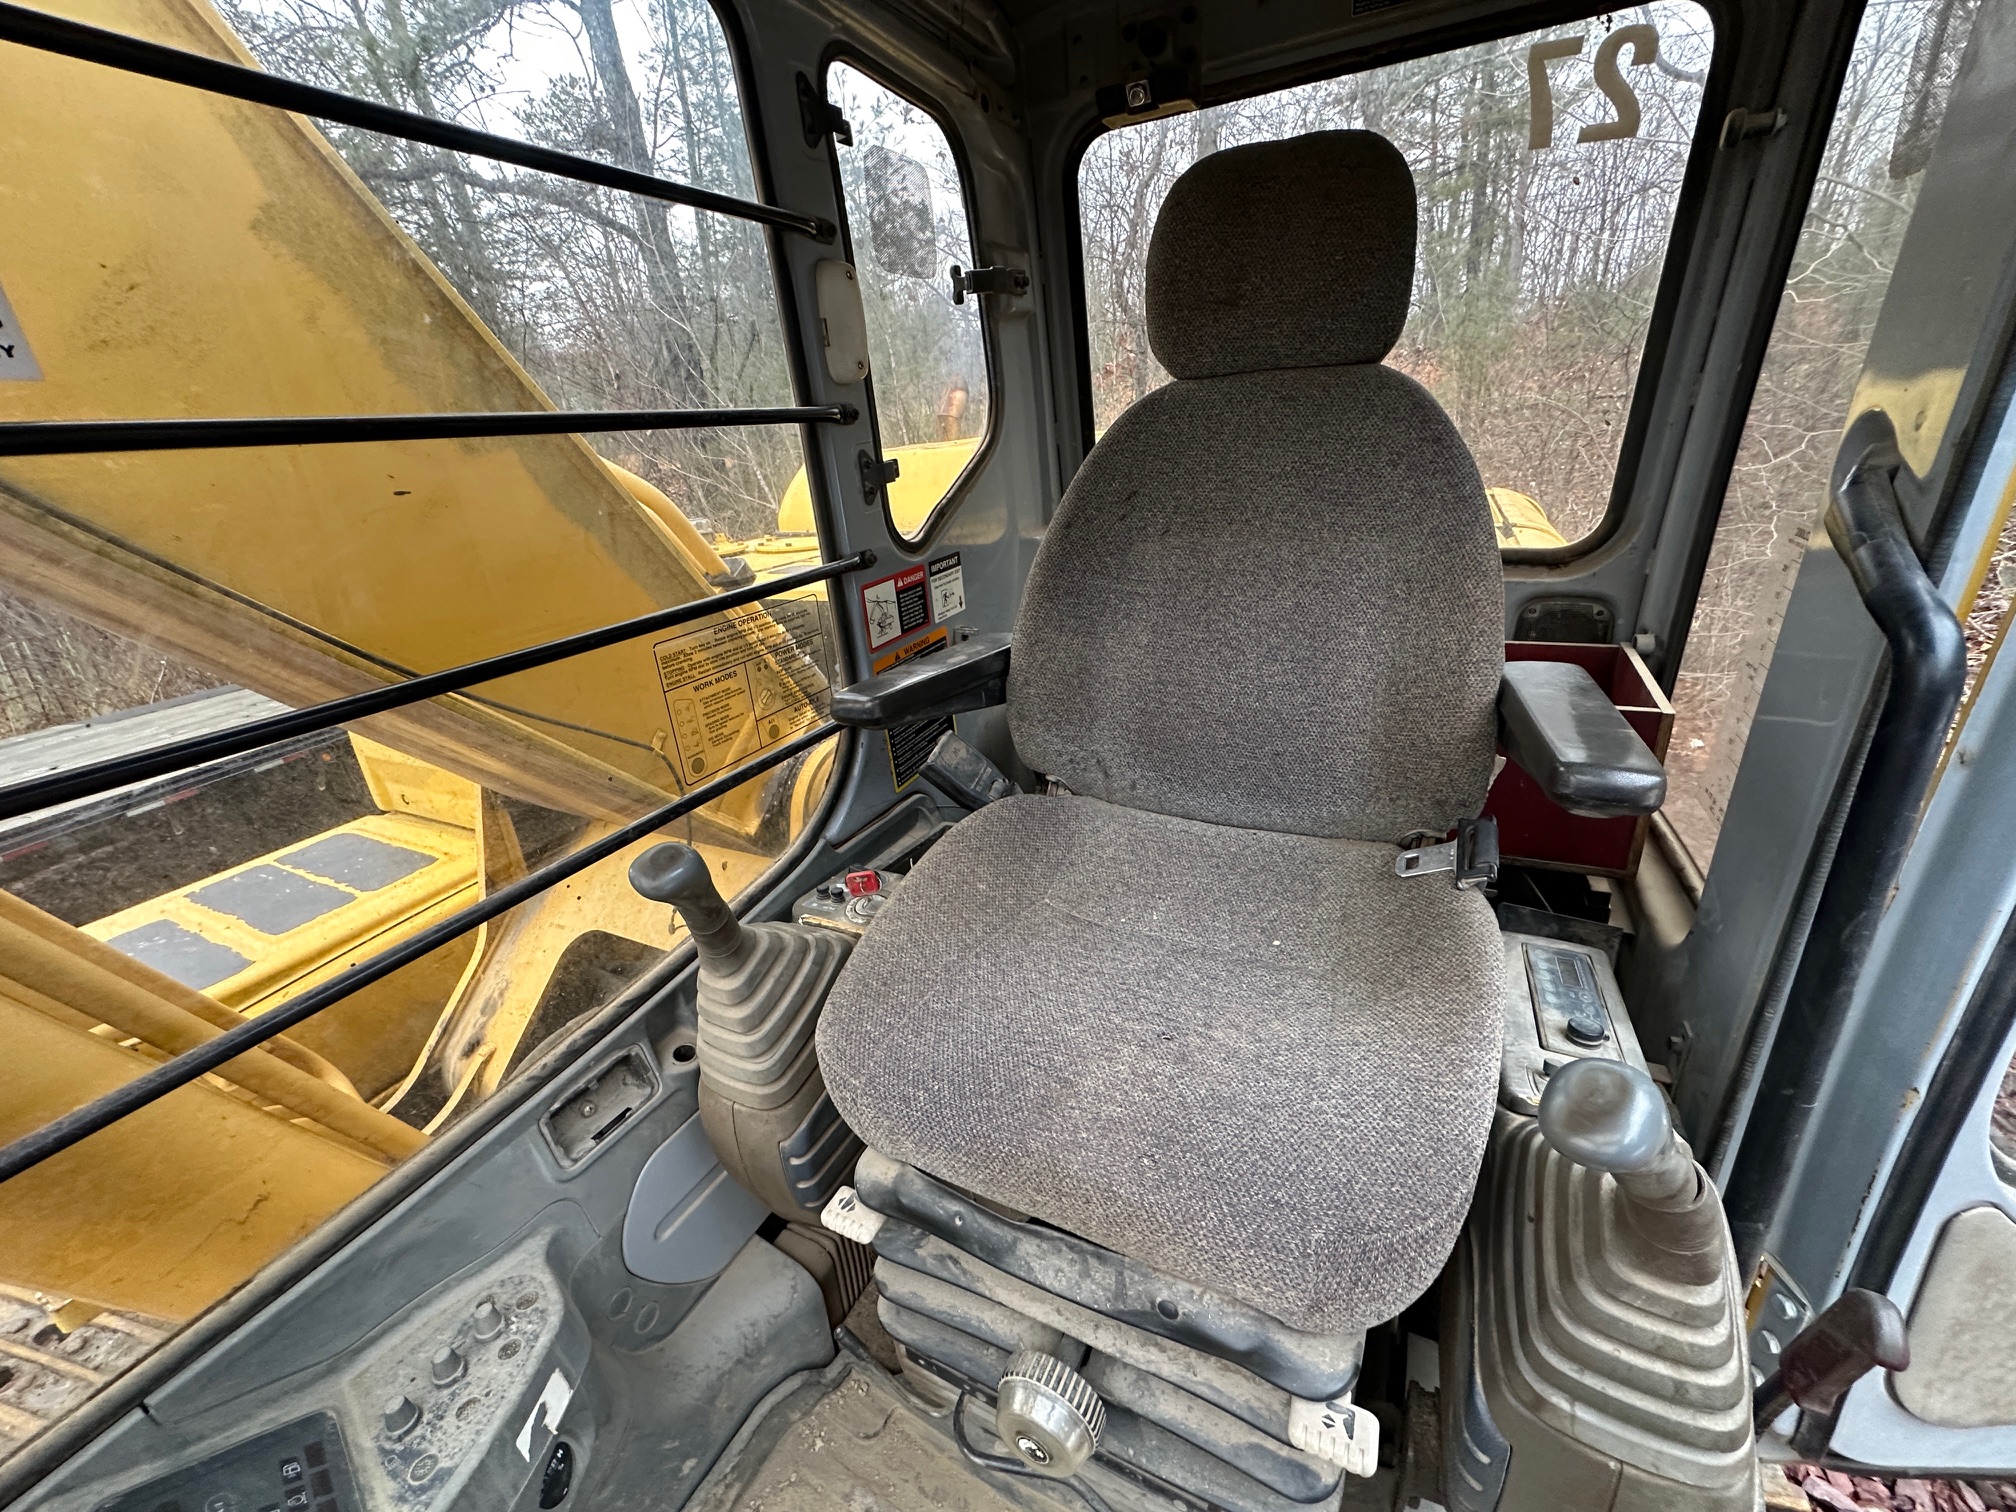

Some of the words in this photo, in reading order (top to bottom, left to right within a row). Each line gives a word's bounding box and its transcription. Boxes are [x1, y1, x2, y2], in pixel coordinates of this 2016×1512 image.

[930, 556, 958, 574] IMPORTANT
[903, 571, 924, 585] DANGER
[713, 622, 737, 635] ENGINE
[737, 611, 772, 627] OPERATION
[774, 646, 795, 658] POWER
[795, 639, 814, 650] MODES
[903, 636, 931, 656] WARNING
[693, 680, 714, 693] WORK
[714, 670, 738, 684] MODES
